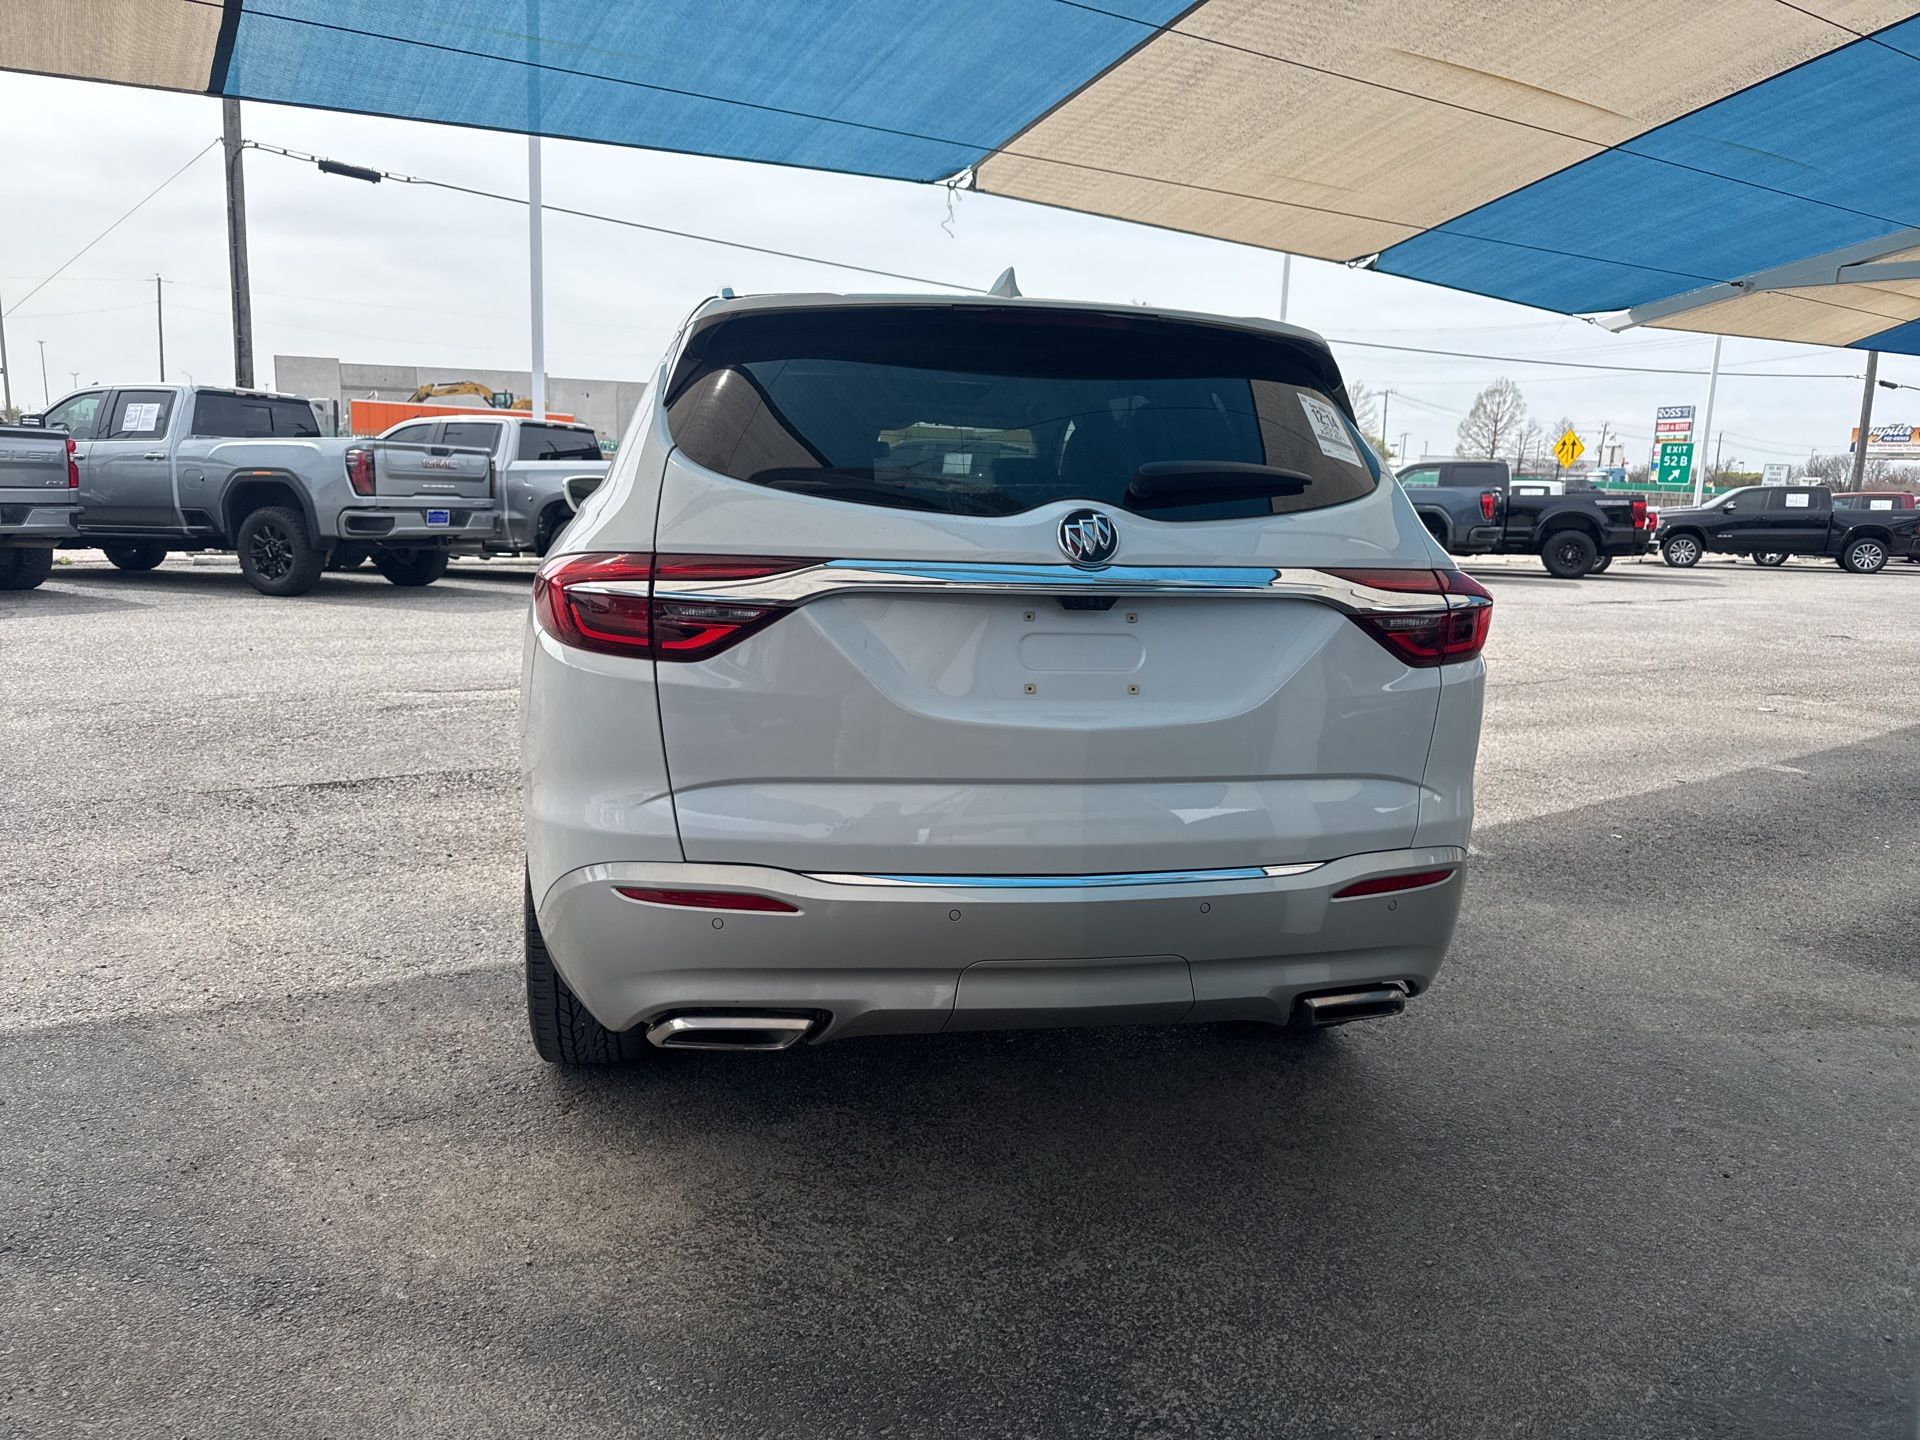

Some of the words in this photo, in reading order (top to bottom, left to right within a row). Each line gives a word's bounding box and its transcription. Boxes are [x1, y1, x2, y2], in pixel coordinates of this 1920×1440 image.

[1658, 408, 1682, 418] ROSS
[1666, 445, 1688, 454] EXIT
[1663, 455, 1678, 466] 52
[1680, 456, 1688, 466] B
